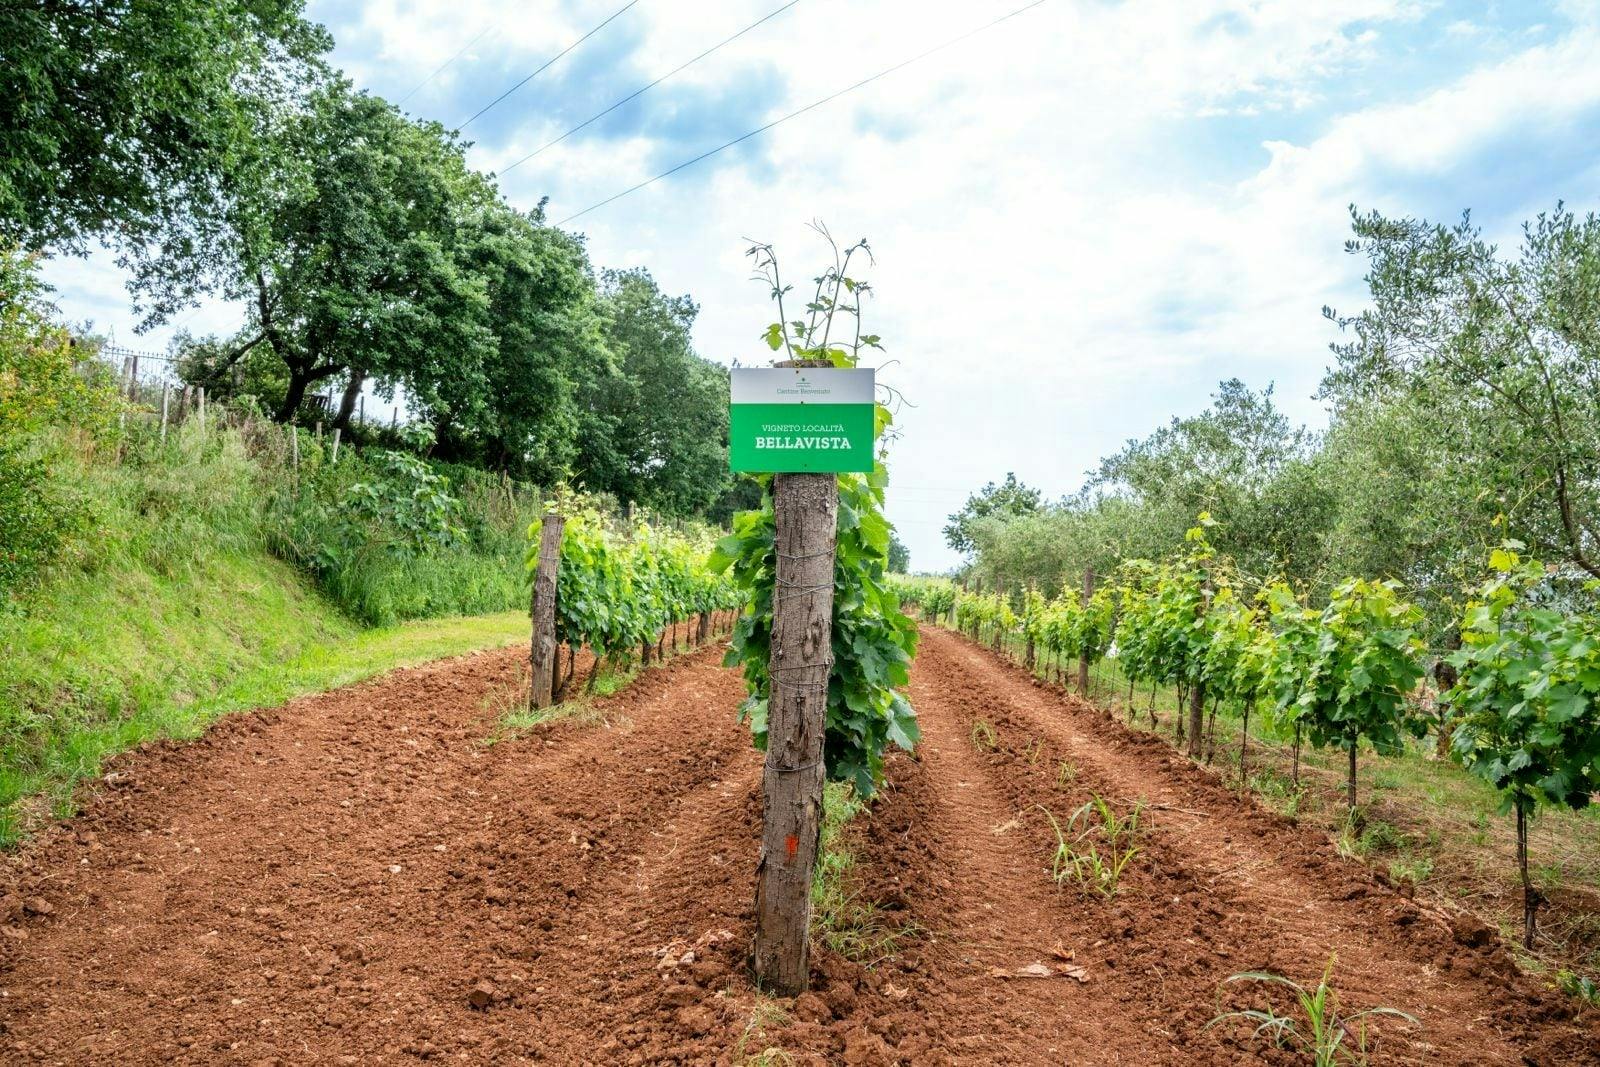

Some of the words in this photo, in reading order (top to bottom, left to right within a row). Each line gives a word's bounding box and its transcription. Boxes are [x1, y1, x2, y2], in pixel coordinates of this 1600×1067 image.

[762, 424, 801, 432] VIGNETO
[802, 423, 844, 432] LOCALITÀ
[755, 437, 852, 449] BELLAVISTA
